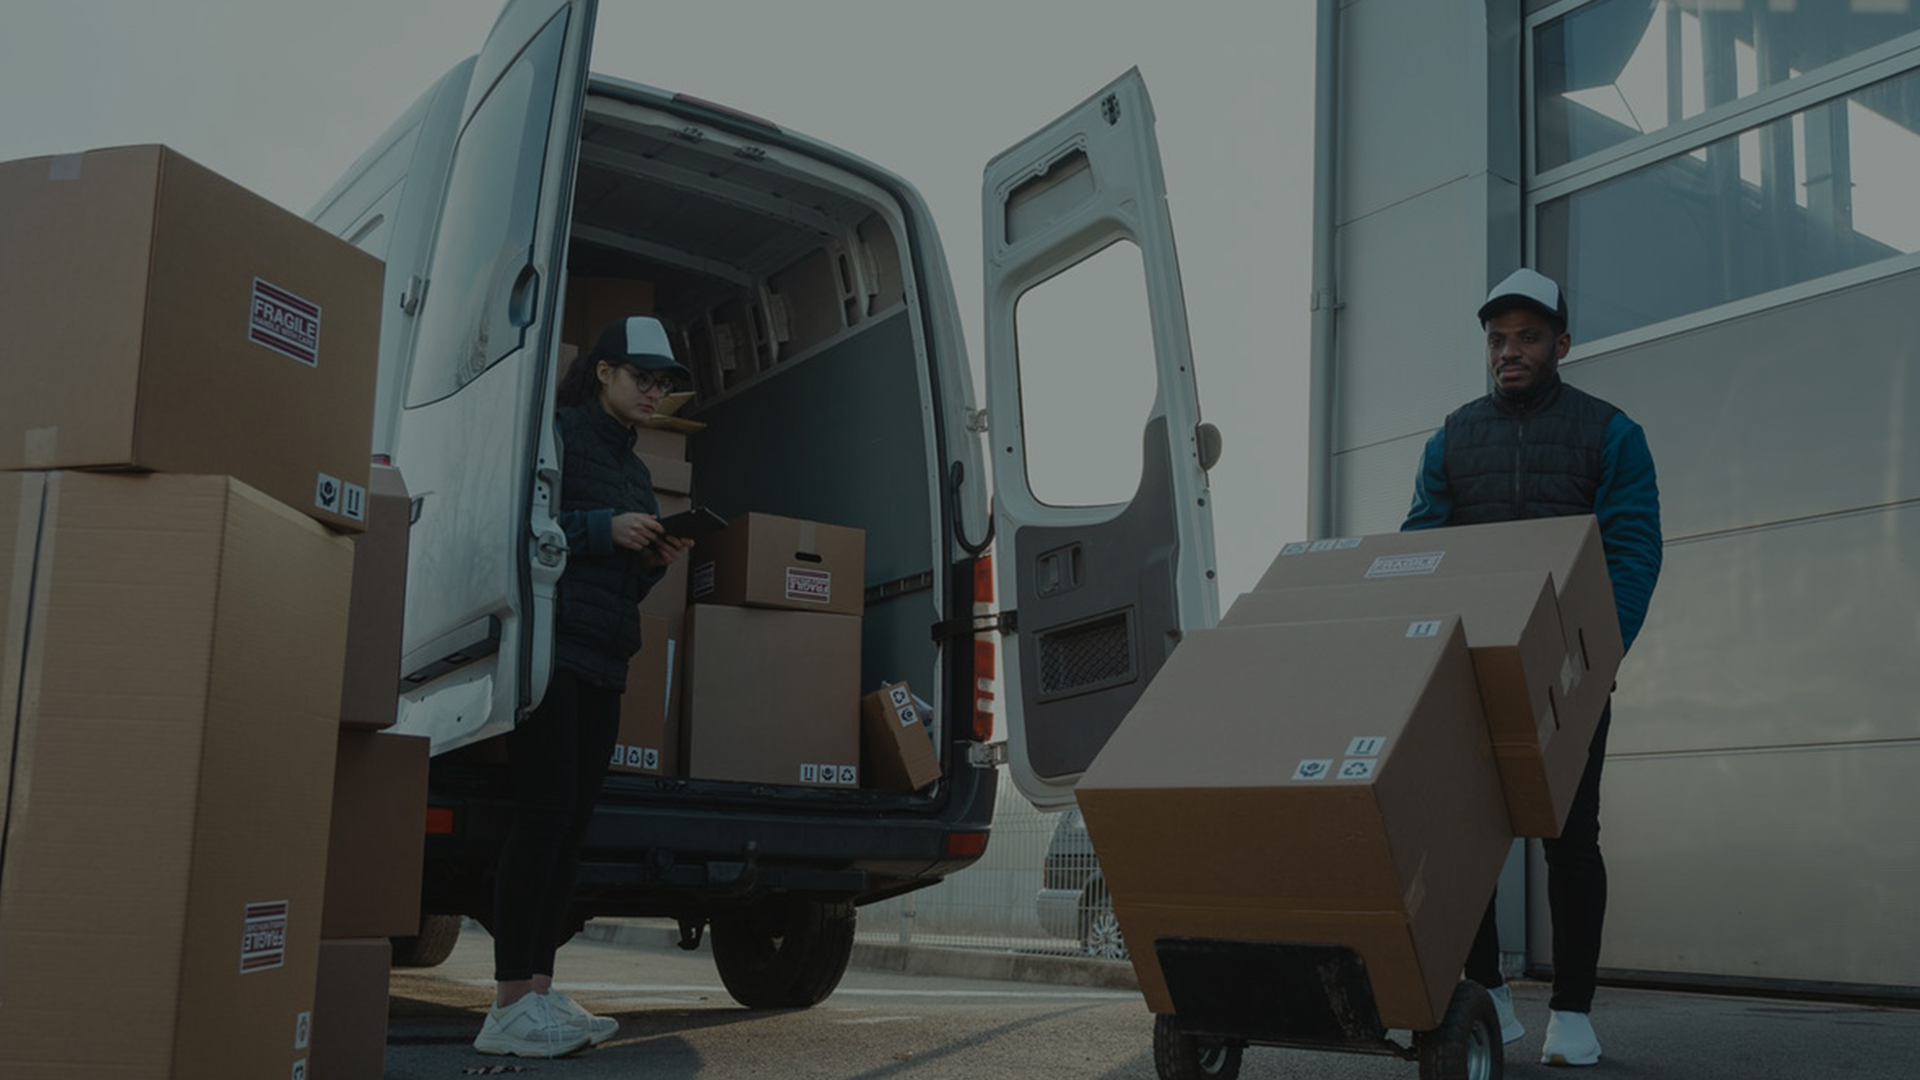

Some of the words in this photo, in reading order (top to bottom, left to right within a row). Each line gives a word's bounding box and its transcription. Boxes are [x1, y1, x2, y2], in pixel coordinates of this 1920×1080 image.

[253, 316, 280, 332] HANDLE
[254, 299, 317, 340] FRAGILE
[244, 929, 284, 951] FRAGILE
